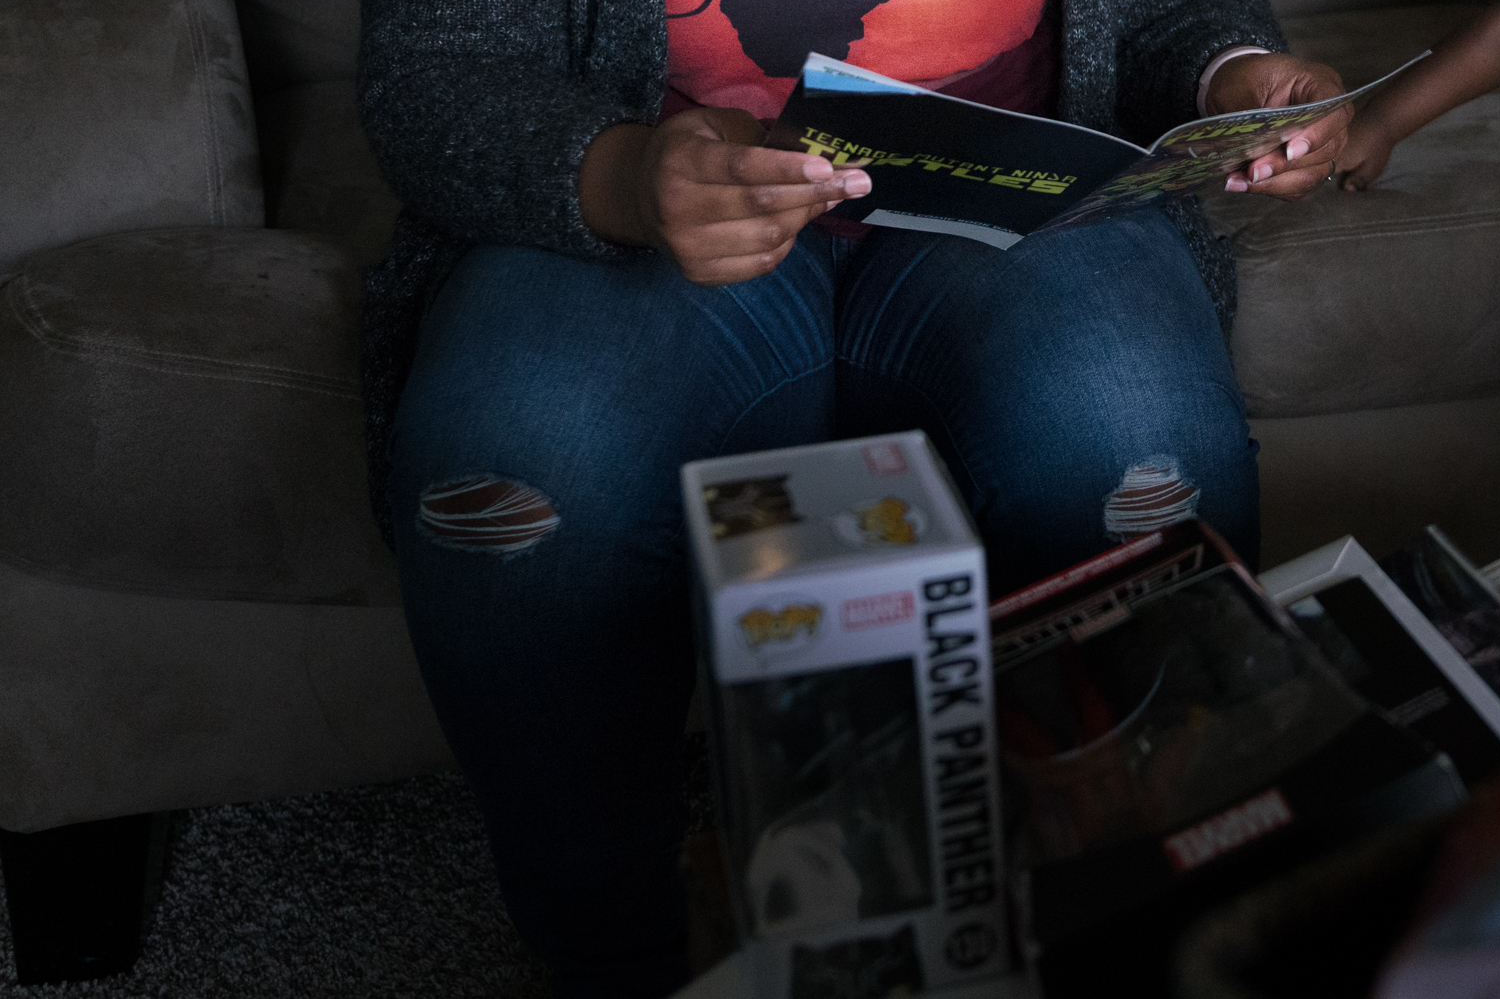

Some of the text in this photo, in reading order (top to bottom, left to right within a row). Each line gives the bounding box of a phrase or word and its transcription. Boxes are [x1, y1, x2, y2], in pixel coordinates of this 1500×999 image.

[799, 136, 1074, 195] TURTLES
[805, 126, 1078, 184] TEENAGE MUTANT NINJA
[923, 572, 981, 715] BLACK
[935, 725, 995, 913] PANTHER
